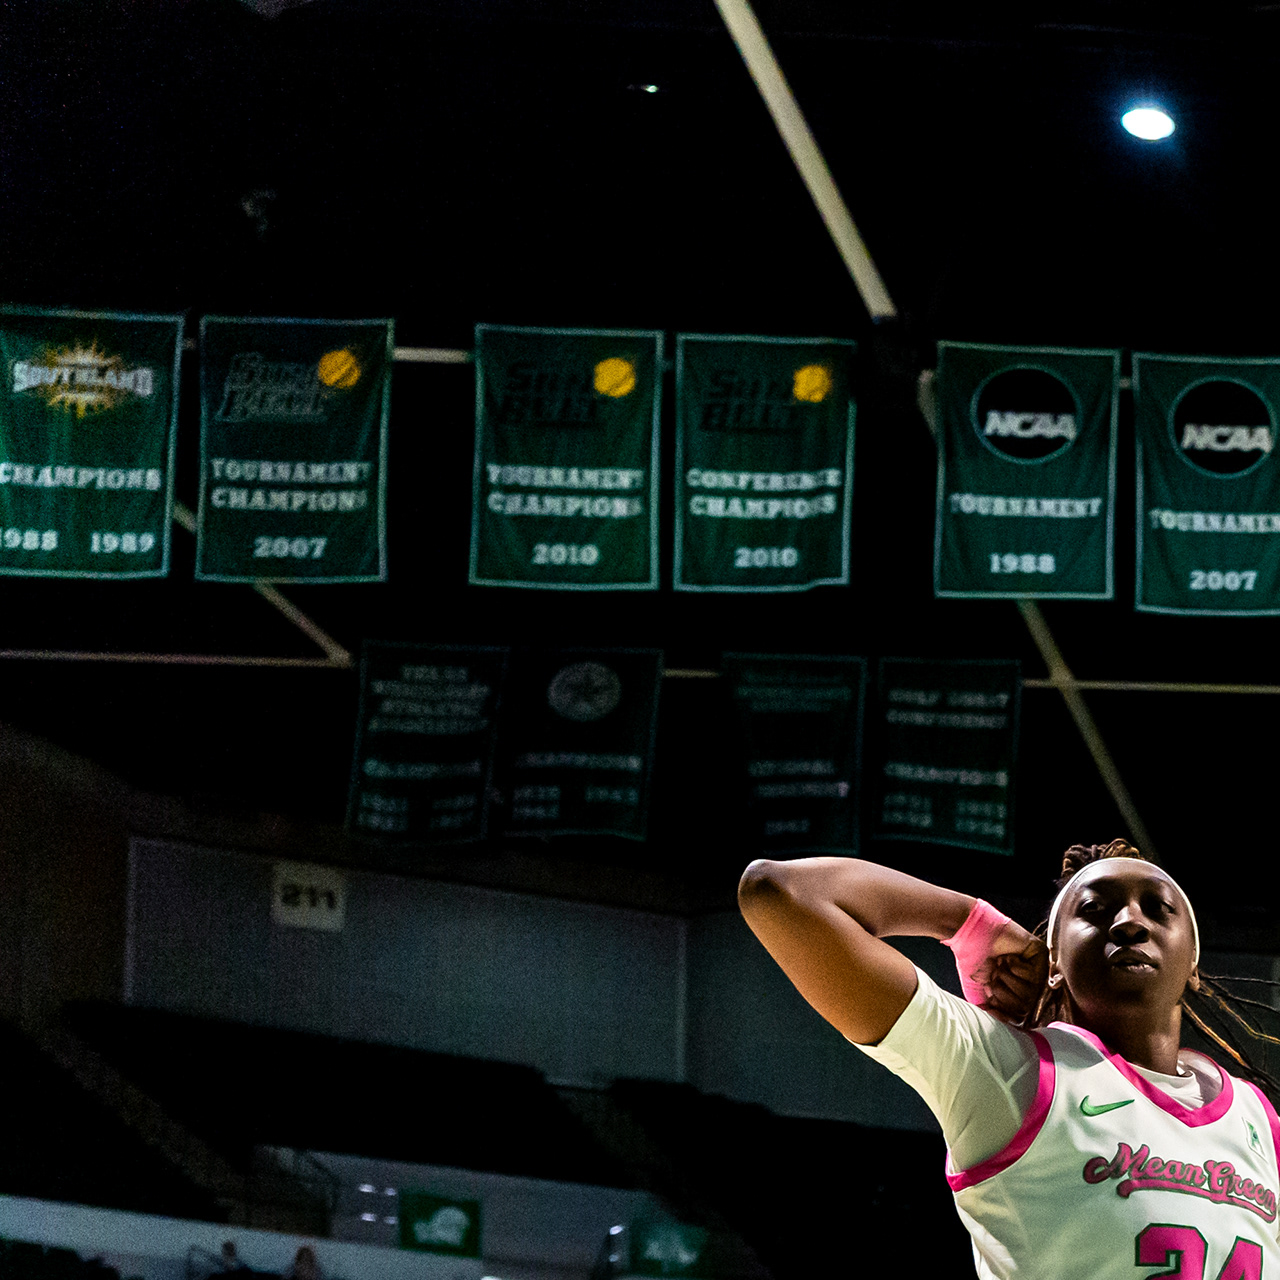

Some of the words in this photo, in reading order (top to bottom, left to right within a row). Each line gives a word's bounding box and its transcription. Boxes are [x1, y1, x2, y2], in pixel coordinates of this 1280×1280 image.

[984, 410, 1077, 440] NCAA
[1182, 424, 1273, 453] NCAA
[0, 462, 161, 490] CHAMPIONS
[211, 457, 372, 483] TOURNAMENT
[486, 463, 644, 489] TOURNAMENT
[686, 468, 841, 491] CONFERENCE
[211, 488, 367, 511] CHAMPIONS
[487, 491, 642, 517] CHAMPIONS
[690, 494, 836, 518] CHAMPIONS
[950, 493, 1102, 518] TOURNAMENT
[0, 527, 58, 551] 988
[253, 536, 327, 558] 2007
[532, 543, 599, 565] 2010
[734, 547, 798, 568] 2010
[990, 553, 1056, 574] 1988
[1189, 570, 1258, 590] 2007
[1083, 1142, 1206, 1186] Mean
[1203, 1159, 1277, 1214] Green
